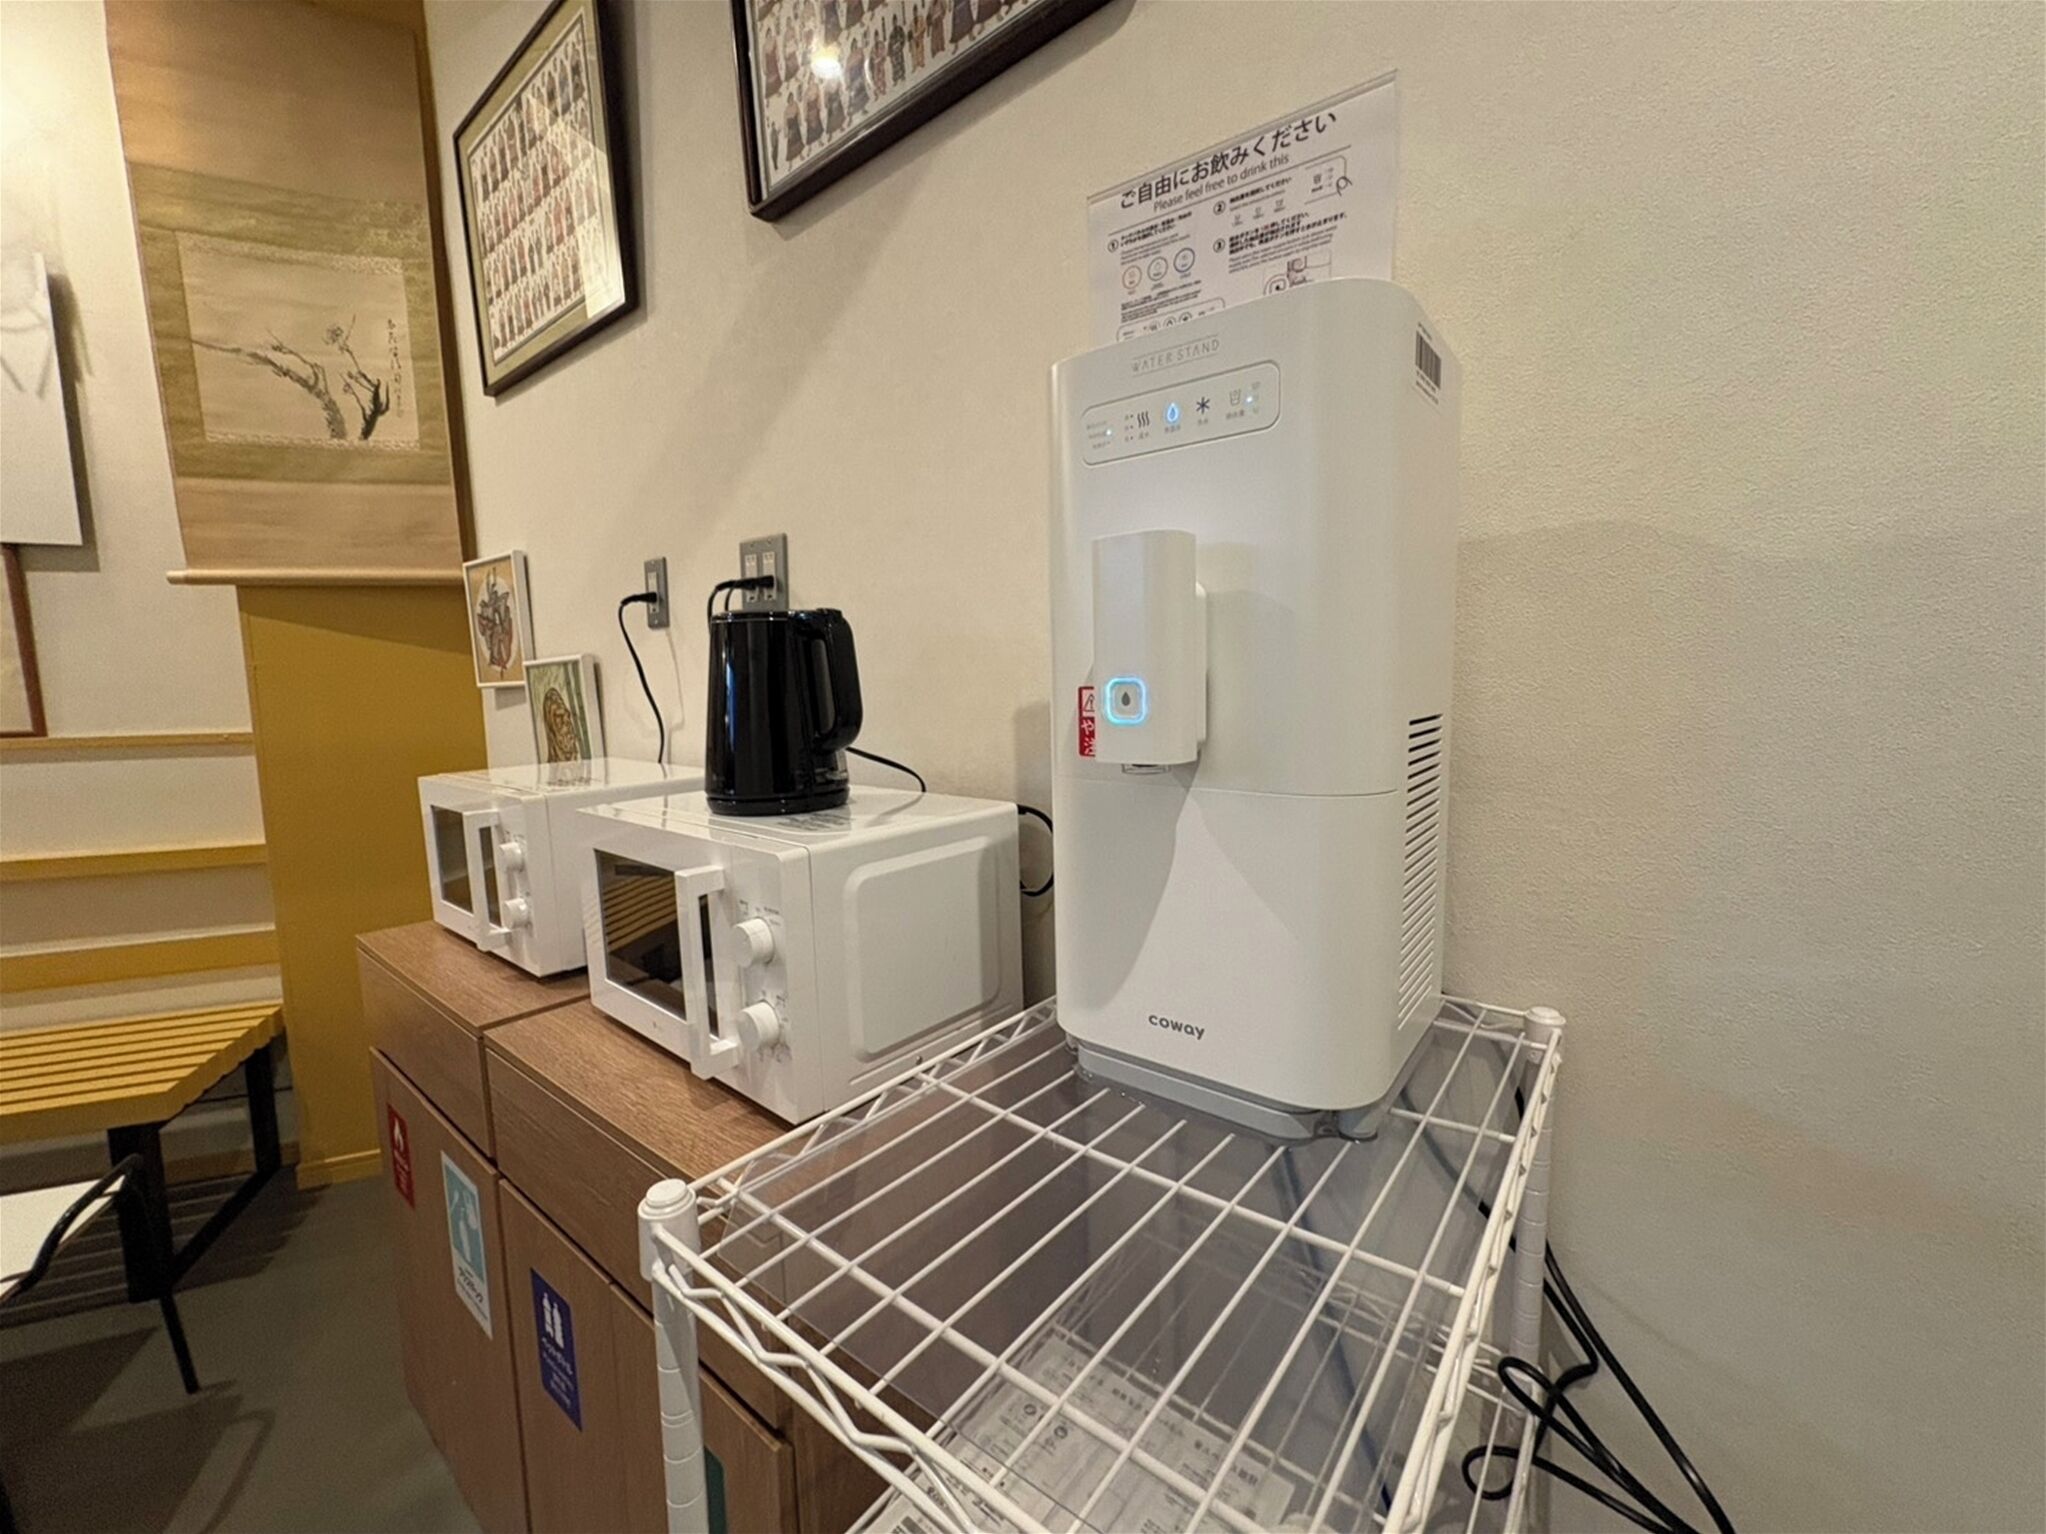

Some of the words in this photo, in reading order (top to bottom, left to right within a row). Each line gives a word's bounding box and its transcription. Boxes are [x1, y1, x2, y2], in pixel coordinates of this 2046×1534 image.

[1120, 111, 1336, 209] ご自由にお飲みください
[1154, 192, 1183, 212] Please
[1185, 184, 1203, 205] feel
[1205, 177, 1225, 197] free
[1227, 173, 1238, 187] to
[1240, 161, 1267, 180] drink
[1270, 153, 1290, 172] this
[1132, 350, 1173, 373] WATER
[1177, 338, 1220, 362] STAND
[1148, 1013, 1205, 1041] coway
